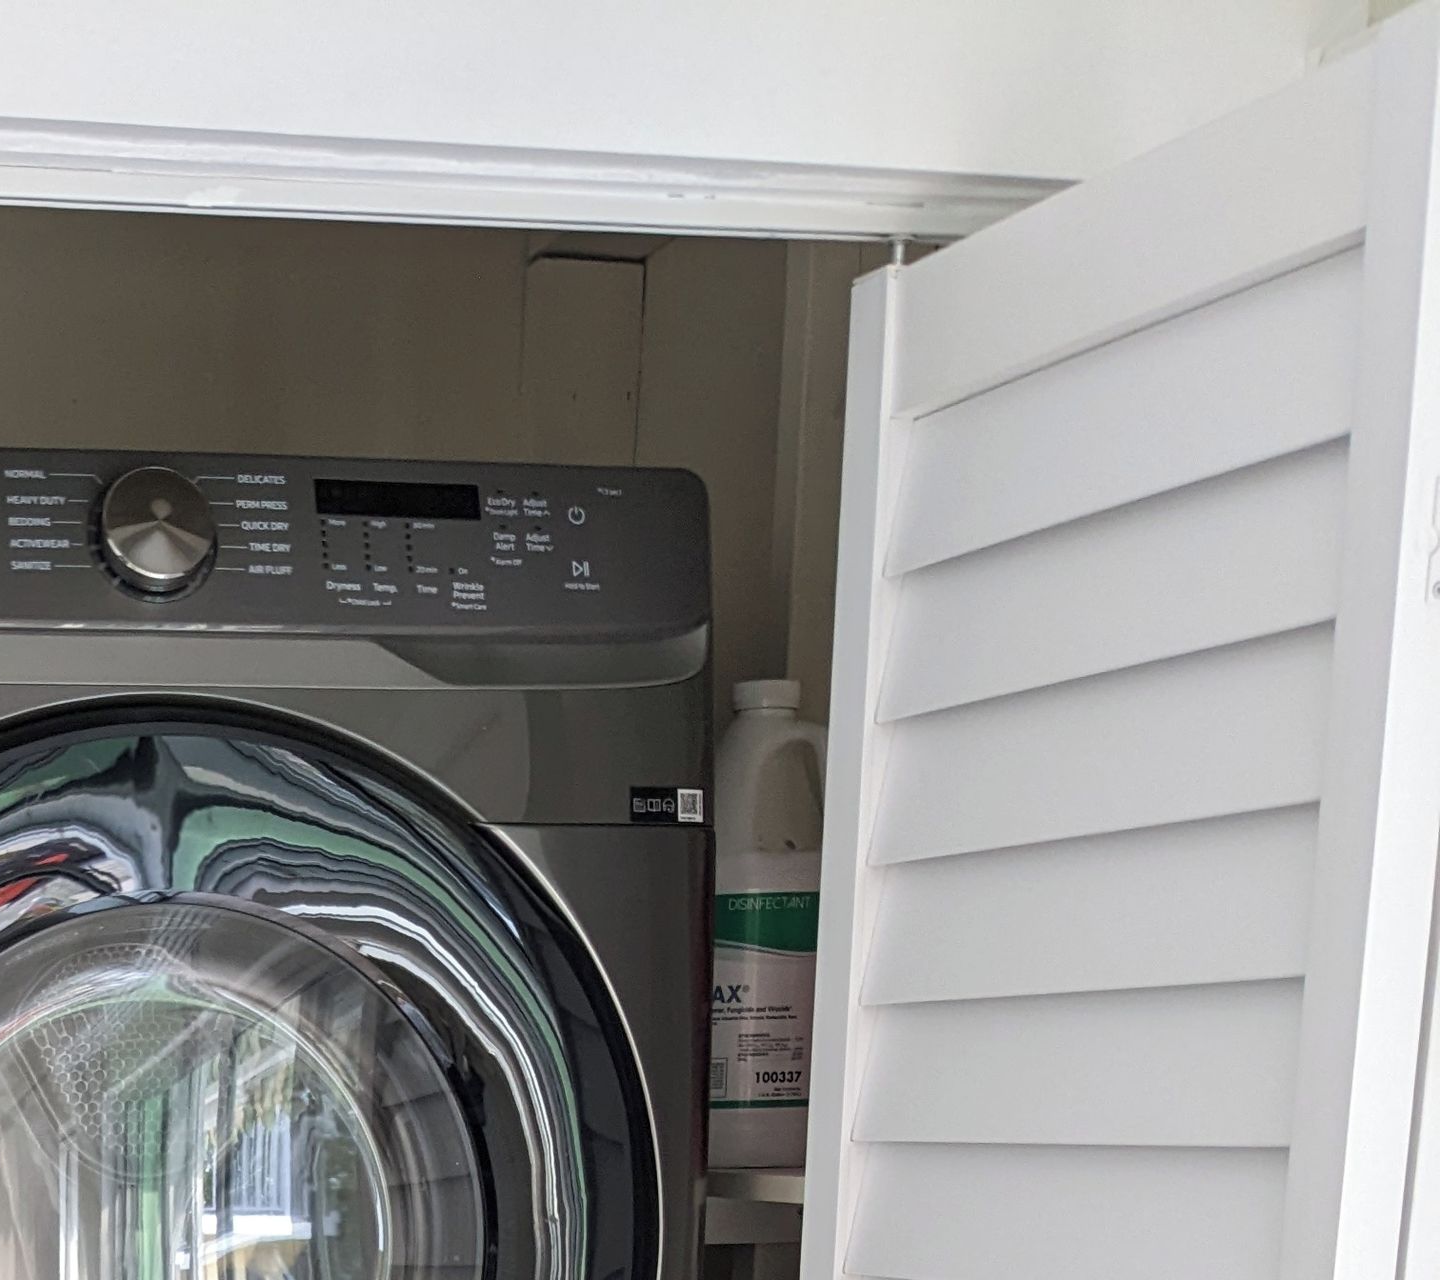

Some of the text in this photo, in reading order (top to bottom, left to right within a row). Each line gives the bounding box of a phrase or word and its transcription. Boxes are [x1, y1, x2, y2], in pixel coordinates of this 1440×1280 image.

[4, 469, 47, 479] NORMAL
[237, 474, 286, 485] DELICATES
[6, 495, 65, 506] HEAVY DUTY
[235, 500, 288, 511] PERM PRESS
[523, 508, 542, 517] Time
[8, 517, 51, 527] BEDDING
[241, 521, 290, 531] QUICK DRY
[9, 539, 70, 549] ACTIVEWEAR
[248, 543, 291, 553] TIME DRY
[526, 543, 545, 552] Time
[9, 561, 52, 571] SANITIZE
[248, 565, 293, 575] AIR FLUFF
[326, 581, 361, 592] Dryness
[373, 582, 398, 594] Temp.
[416, 584, 438, 594] Time
[452, 582, 484, 592] Wrinkle
[453, 591, 484, 600] Prevent
[728, 896, 811, 912] DISINFECTANT
[755, 1071, 802, 1083] 100337
